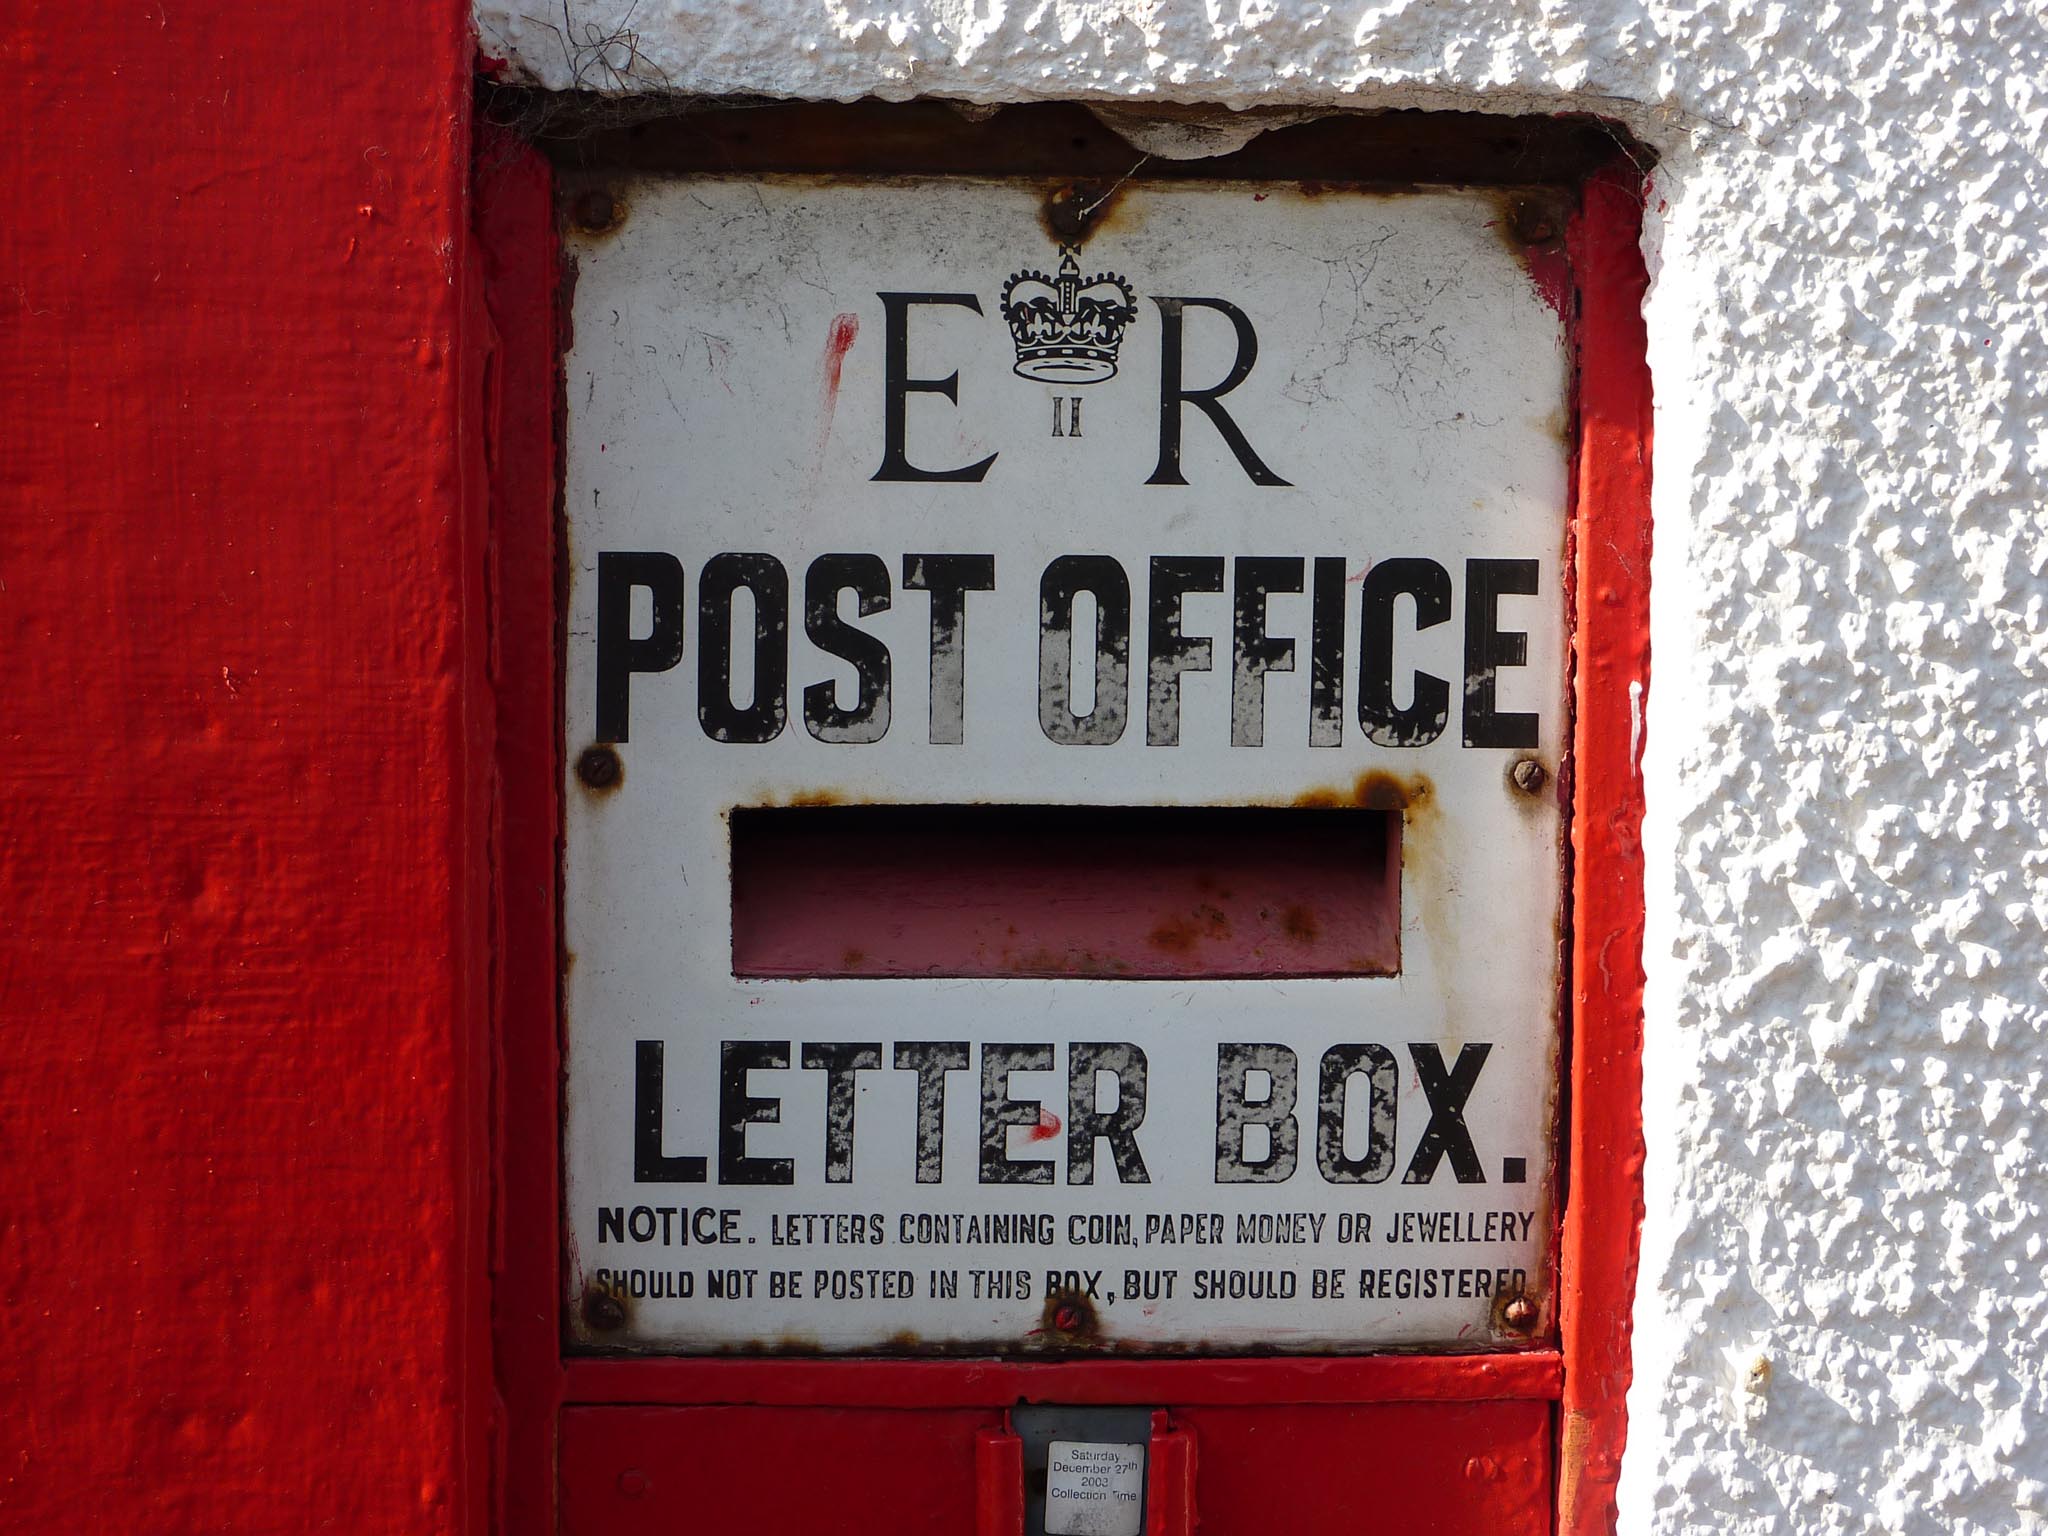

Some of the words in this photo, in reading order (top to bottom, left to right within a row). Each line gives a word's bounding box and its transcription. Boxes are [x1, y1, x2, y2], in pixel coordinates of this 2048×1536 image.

[870, 291, 999, 483] E
[1144, 295, 1295, 488] R
[1051, 396, 1083, 437] II
[596, 552, 996, 745] POST
[1037, 555, 1540, 749] OFFICE
[633, 1040, 1149, 1186] LETTER
[1215, 1042, 1528, 1185] BOX.
[597, 1206, 757, 1246] NOTICE.
[771, 1213, 885, 1245] LETTERS
[899, 1213, 1055, 1245] CONTAINING
[1067, 1213, 1138, 1249] COIN,
[1145, 1212, 1225, 1245] PAPER
[1237, 1212, 1327, 1245] MONEY
[1337, 1212, 1372, 1245] OR
[1386, 1211, 1536, 1245] JEWELLERY
[596, 1268, 695, 1299] SHOULD
[708, 1269, 758, 1299] NOT
[769, 1269, 802, 1299] BE
[813, 1269, 914, 1300] POSTED
[930, 1270, 958, 1299] IN
[968, 1269, 1032, 1300] THIS
[1046, 1270, 1115, 1306] BOX,
[1123, 1269, 1178, 1300] BUT
[1192, 1269, 1297, 1300] SHOULD
[1311, 1269, 1345, 1299] BE
[1359, 1269, 1527, 1299] REGISTERED
[1053, 1461, 1112, 1474] December
[1114, 1461, 1138, 1474] 27th
[1071, 1449, 1121, 1463] Saturday
[1051, 1487, 1107, 1500] Collection
[1081, 1476, 1109, 1487] 2003
